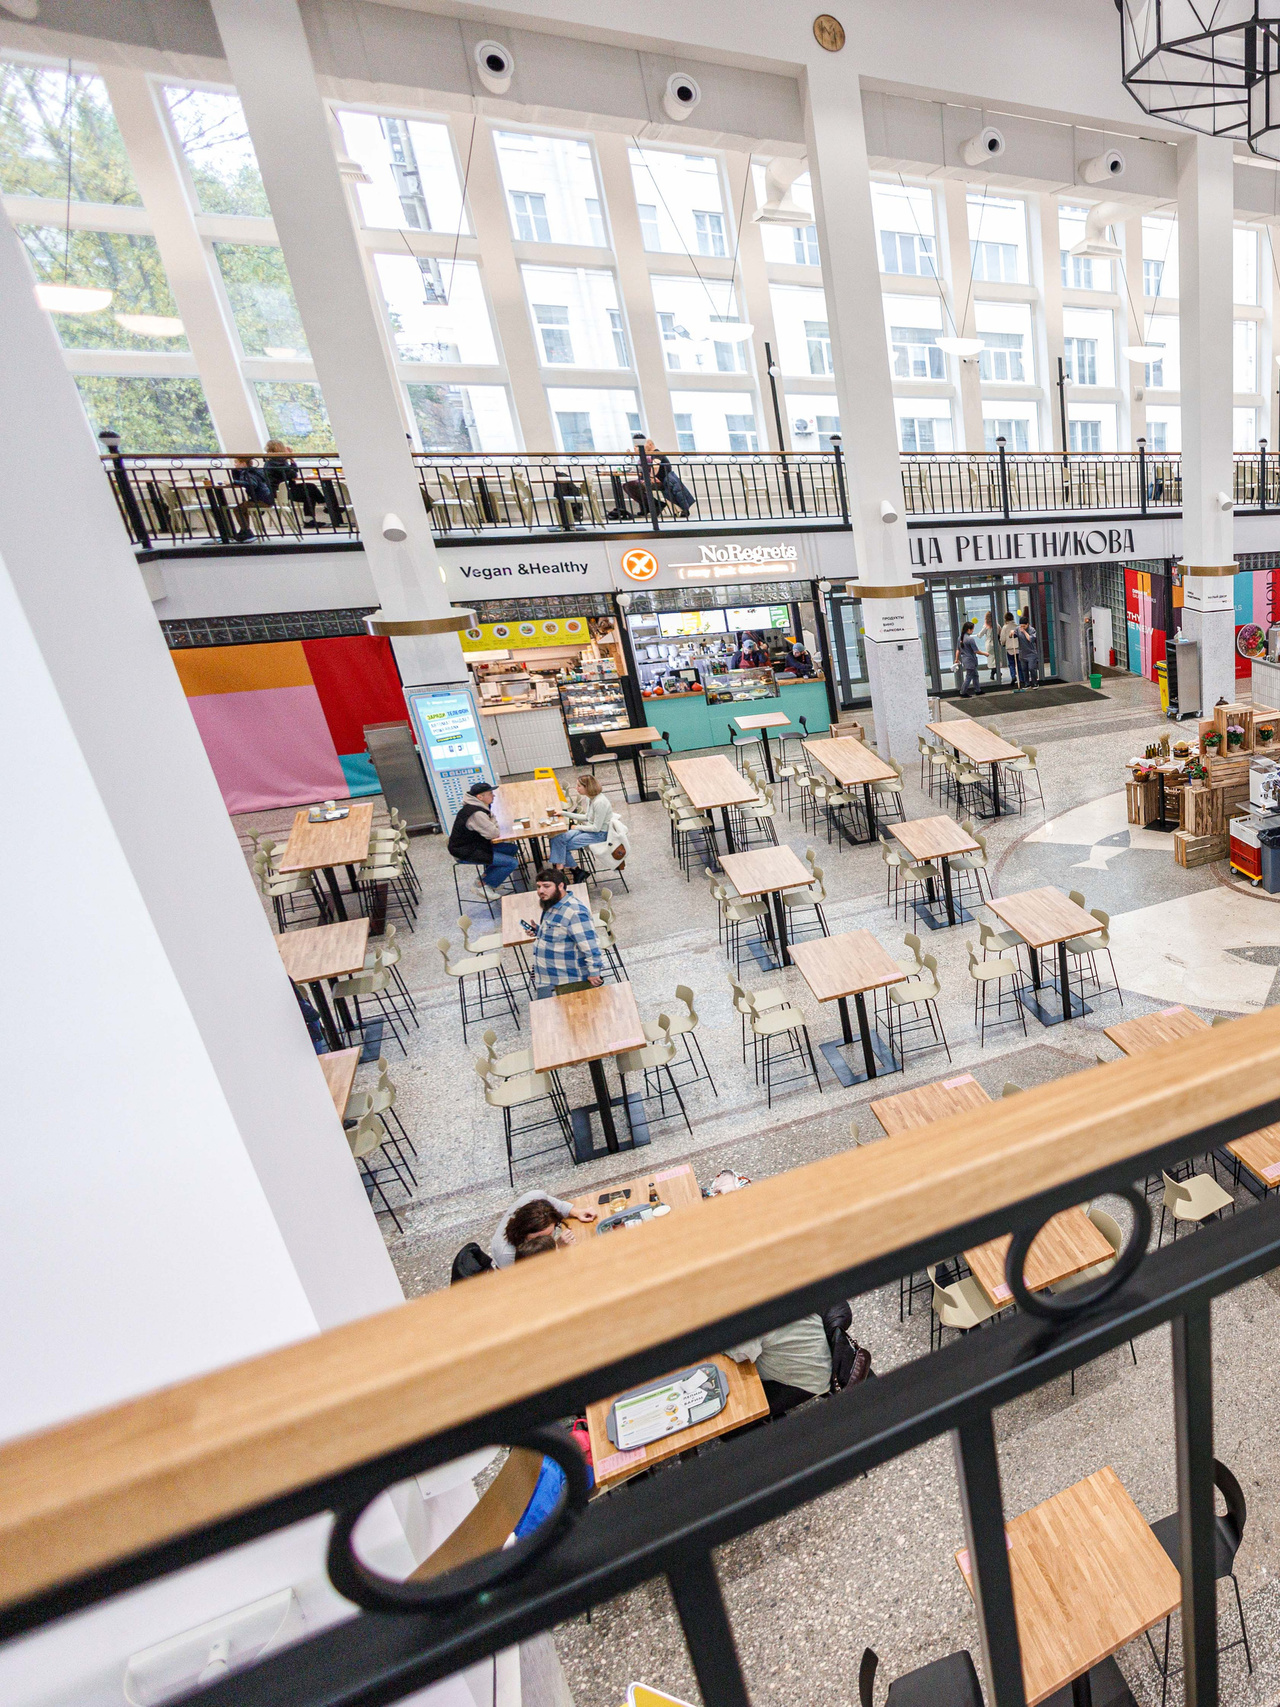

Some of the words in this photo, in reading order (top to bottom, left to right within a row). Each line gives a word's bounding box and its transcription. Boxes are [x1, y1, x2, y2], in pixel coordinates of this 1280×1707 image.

[698, 542, 798, 564] NoRegrets
[956, 528, 1135, 563] РЕШЕТНИКОВА
[459, 565, 513, 580] Vegan
[517, 560, 589, 576] &Healthy
[1127, 611, 1141, 622] THY
